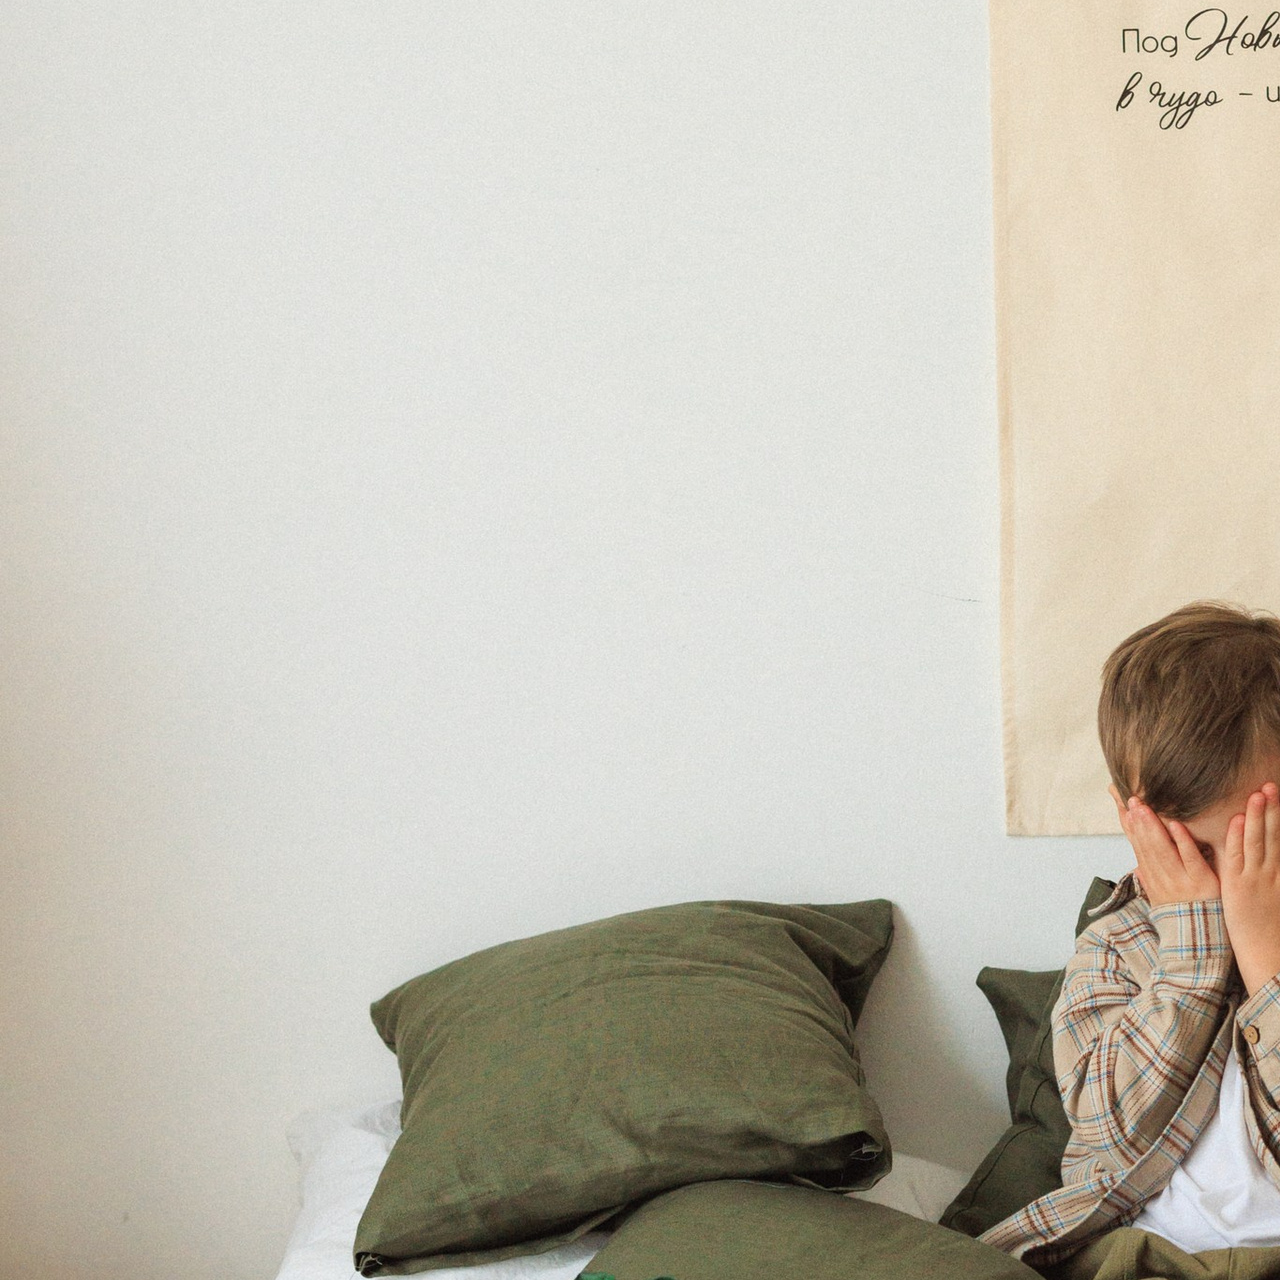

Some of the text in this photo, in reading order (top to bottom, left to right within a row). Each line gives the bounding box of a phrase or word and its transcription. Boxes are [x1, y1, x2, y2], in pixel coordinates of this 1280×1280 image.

[1121, 27, 1178, 58] Под
[1115, 71, 1143, 112] в
[1149, 80, 1224, 131] чудо
[1266, 85, 1280, 103] и
